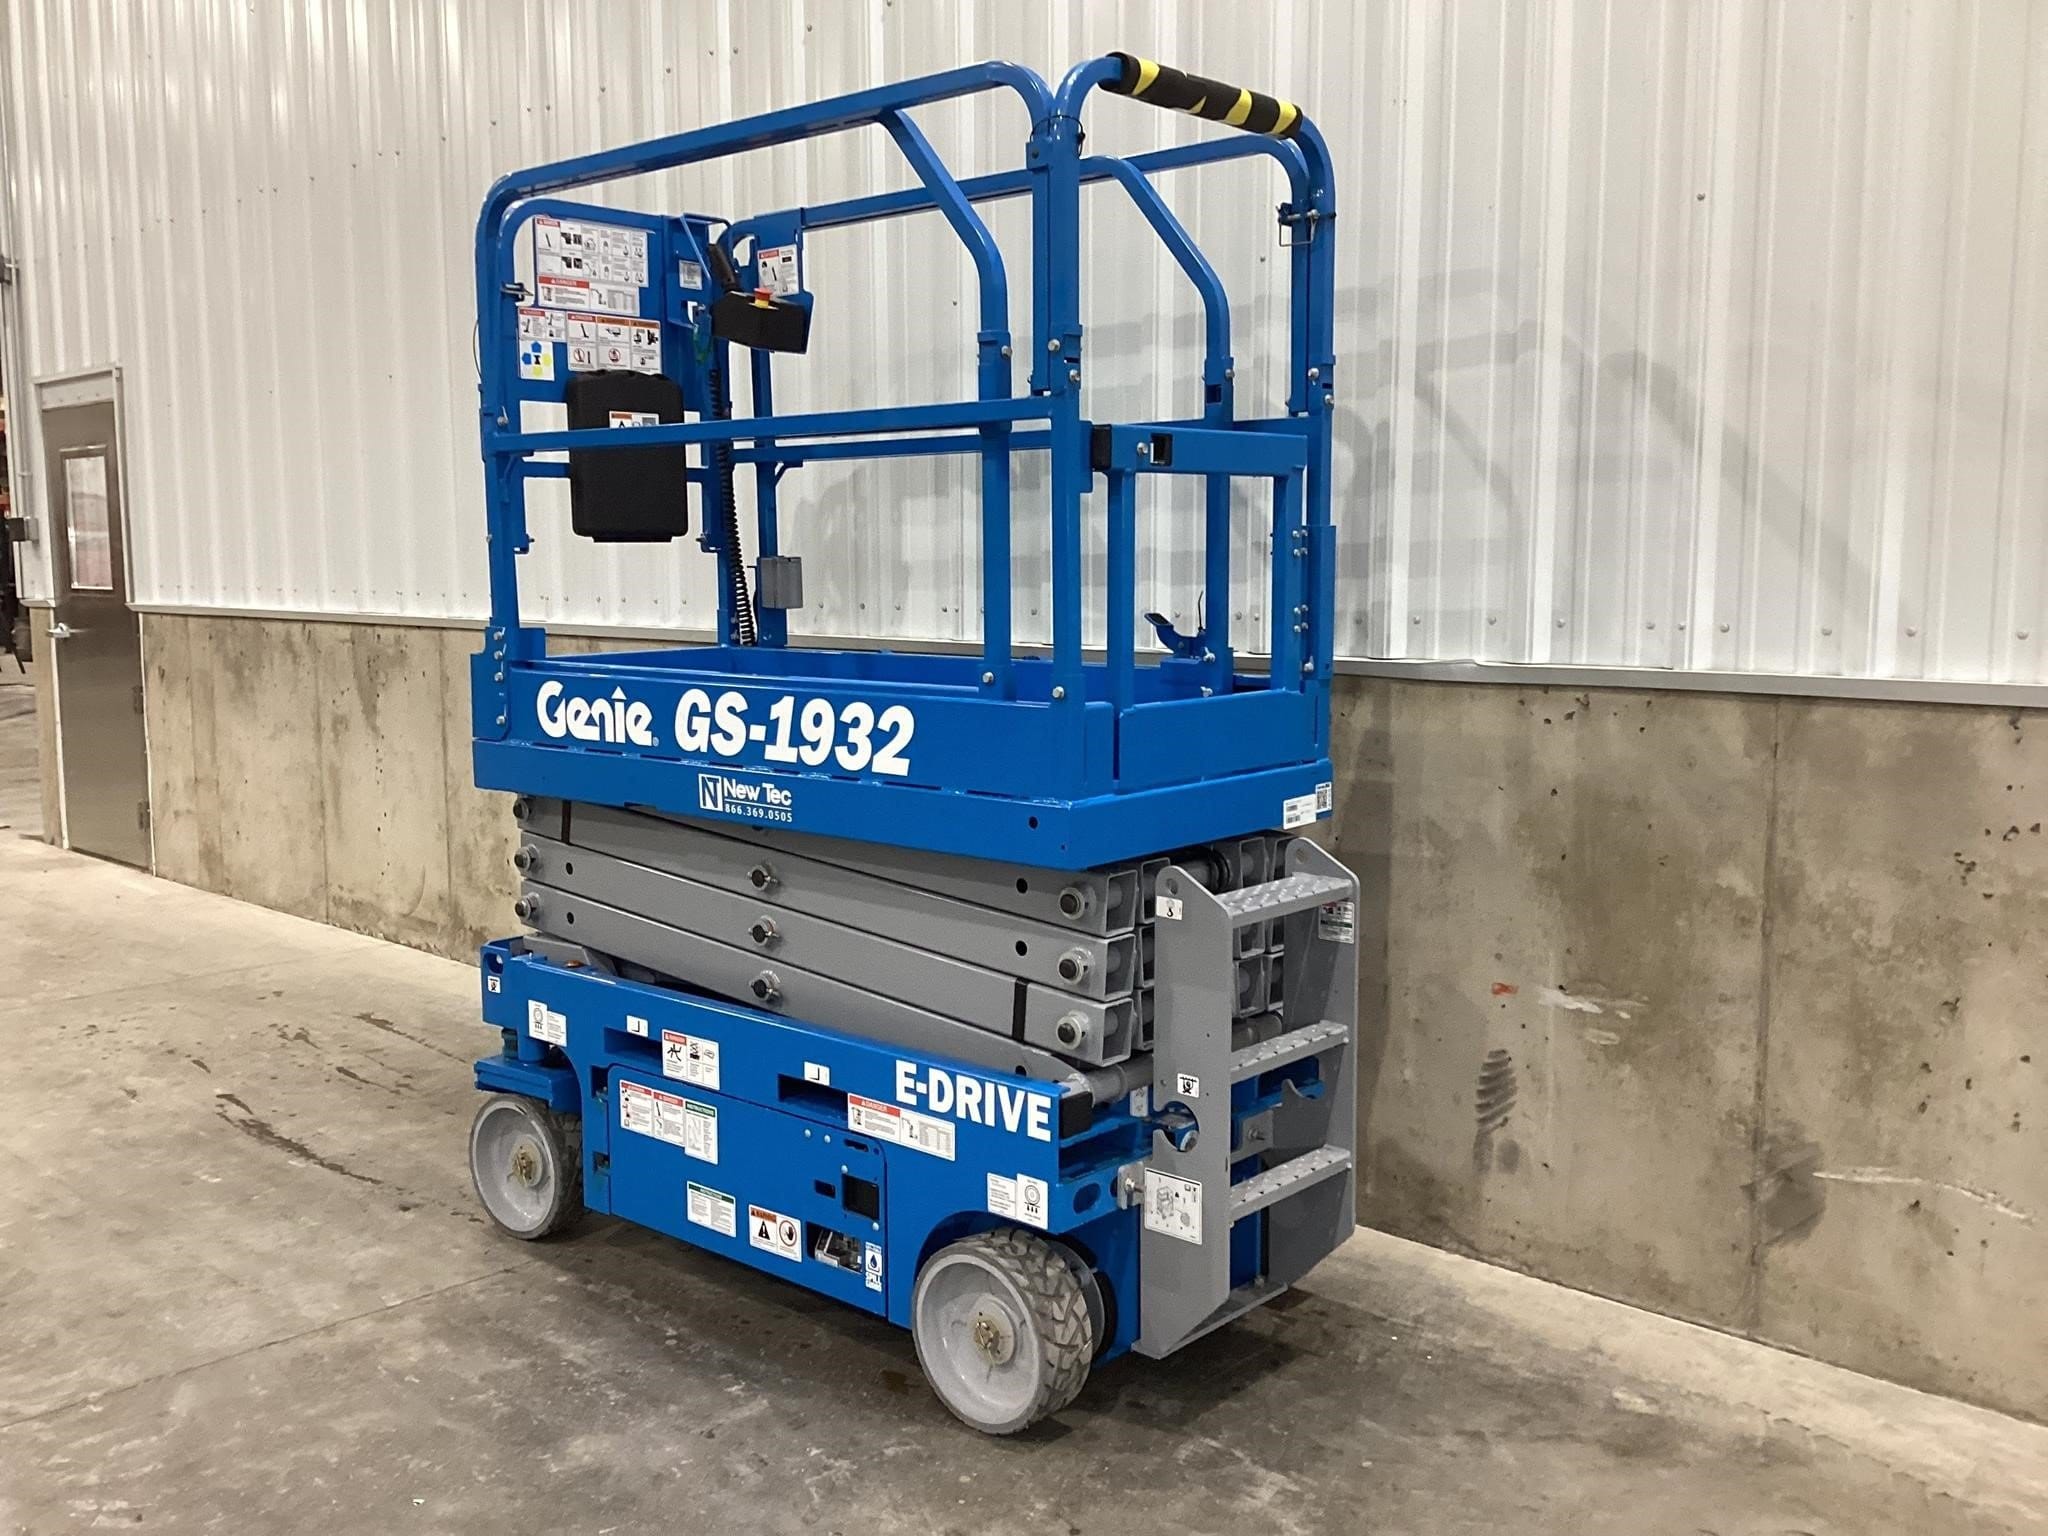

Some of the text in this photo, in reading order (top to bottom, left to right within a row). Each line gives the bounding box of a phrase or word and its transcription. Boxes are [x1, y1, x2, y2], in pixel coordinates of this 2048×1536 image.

[537, 680, 915, 777] Genie GS-1932
[723, 777, 792, 806] New Tec
[724, 803, 793, 823] 866.369.0505
[895, 1059, 1052, 1142] E-DRIVE
